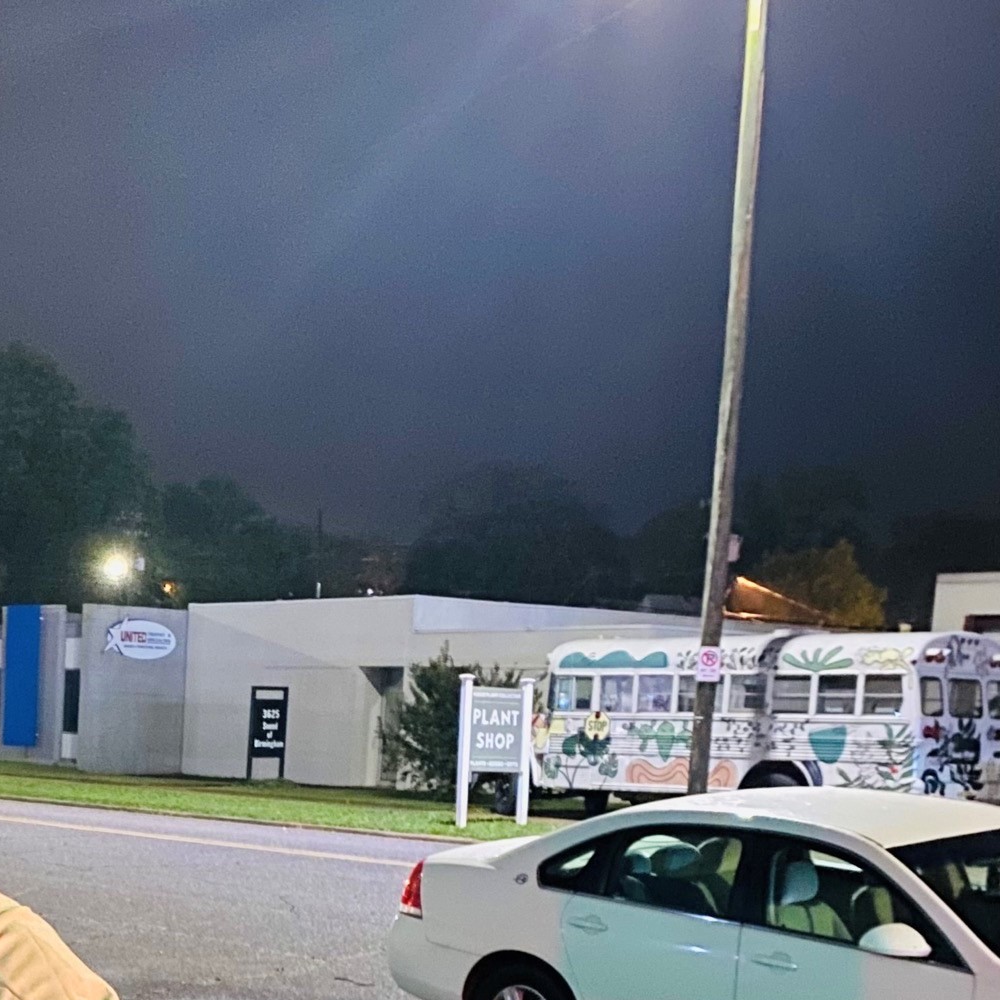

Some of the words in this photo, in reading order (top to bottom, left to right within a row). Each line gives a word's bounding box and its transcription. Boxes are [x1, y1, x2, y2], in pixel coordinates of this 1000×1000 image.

[120, 630, 147, 643] UNITED
[262, 708, 280, 719] 3625
[472, 708, 520, 727] PLANT
[588, 720, 608, 732] STOP
[475, 731, 515, 750] SHOP
